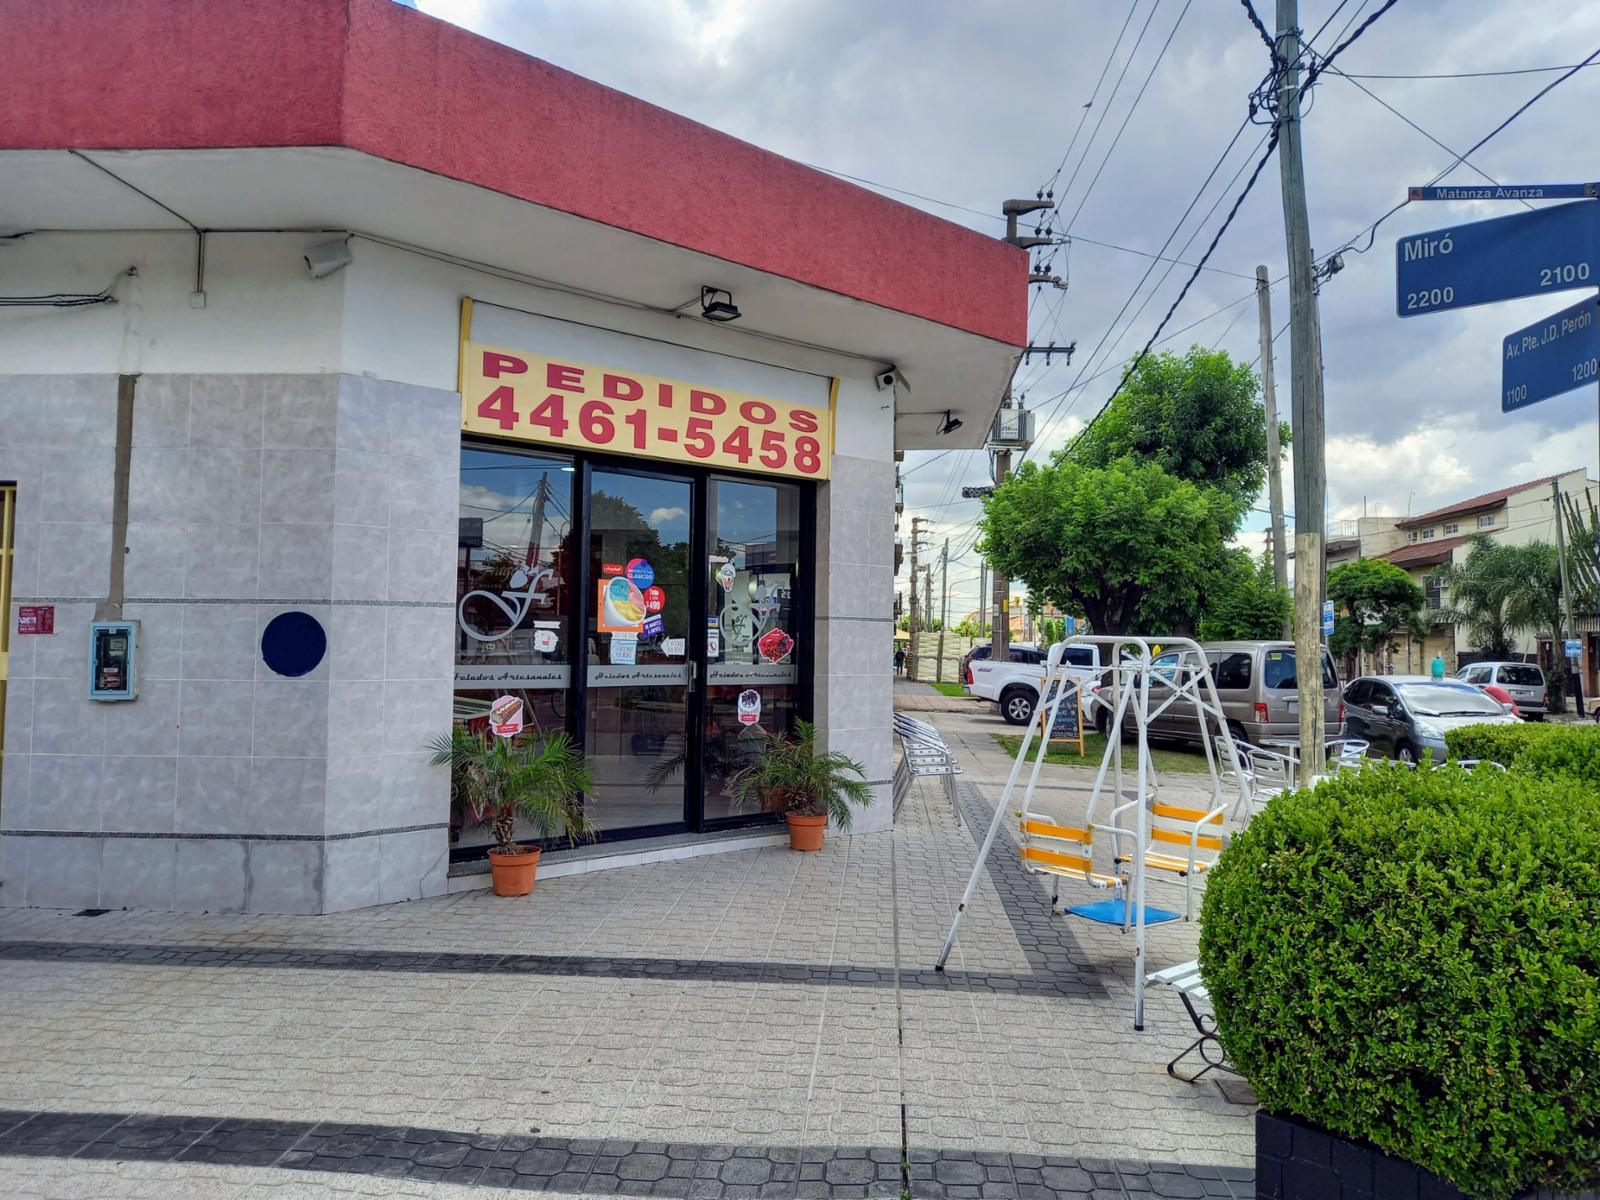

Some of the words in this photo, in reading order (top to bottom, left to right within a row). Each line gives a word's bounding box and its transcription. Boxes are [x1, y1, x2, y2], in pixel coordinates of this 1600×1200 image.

[1436, 188, 1491, 199] Matanza
[1495, 187, 1543, 198] Avanza
[1404, 233, 1454, 262] Miró
[1540, 262, 1590, 287] 2100
[1407, 286, 1454, 310] 2200
[1506, 344, 1520, 360] Av.
[1522, 336, 1539, 354] Pte.
[1541, 324, 1560, 343] J.D.
[1561, 310, 1591, 338] Perón
[1571, 357, 1597, 382] 1200
[483, 351, 819, 434] PEDIDOS
[1506, 384, 1527, 405] 1100
[478, 385, 821, 474] 4461-5458
